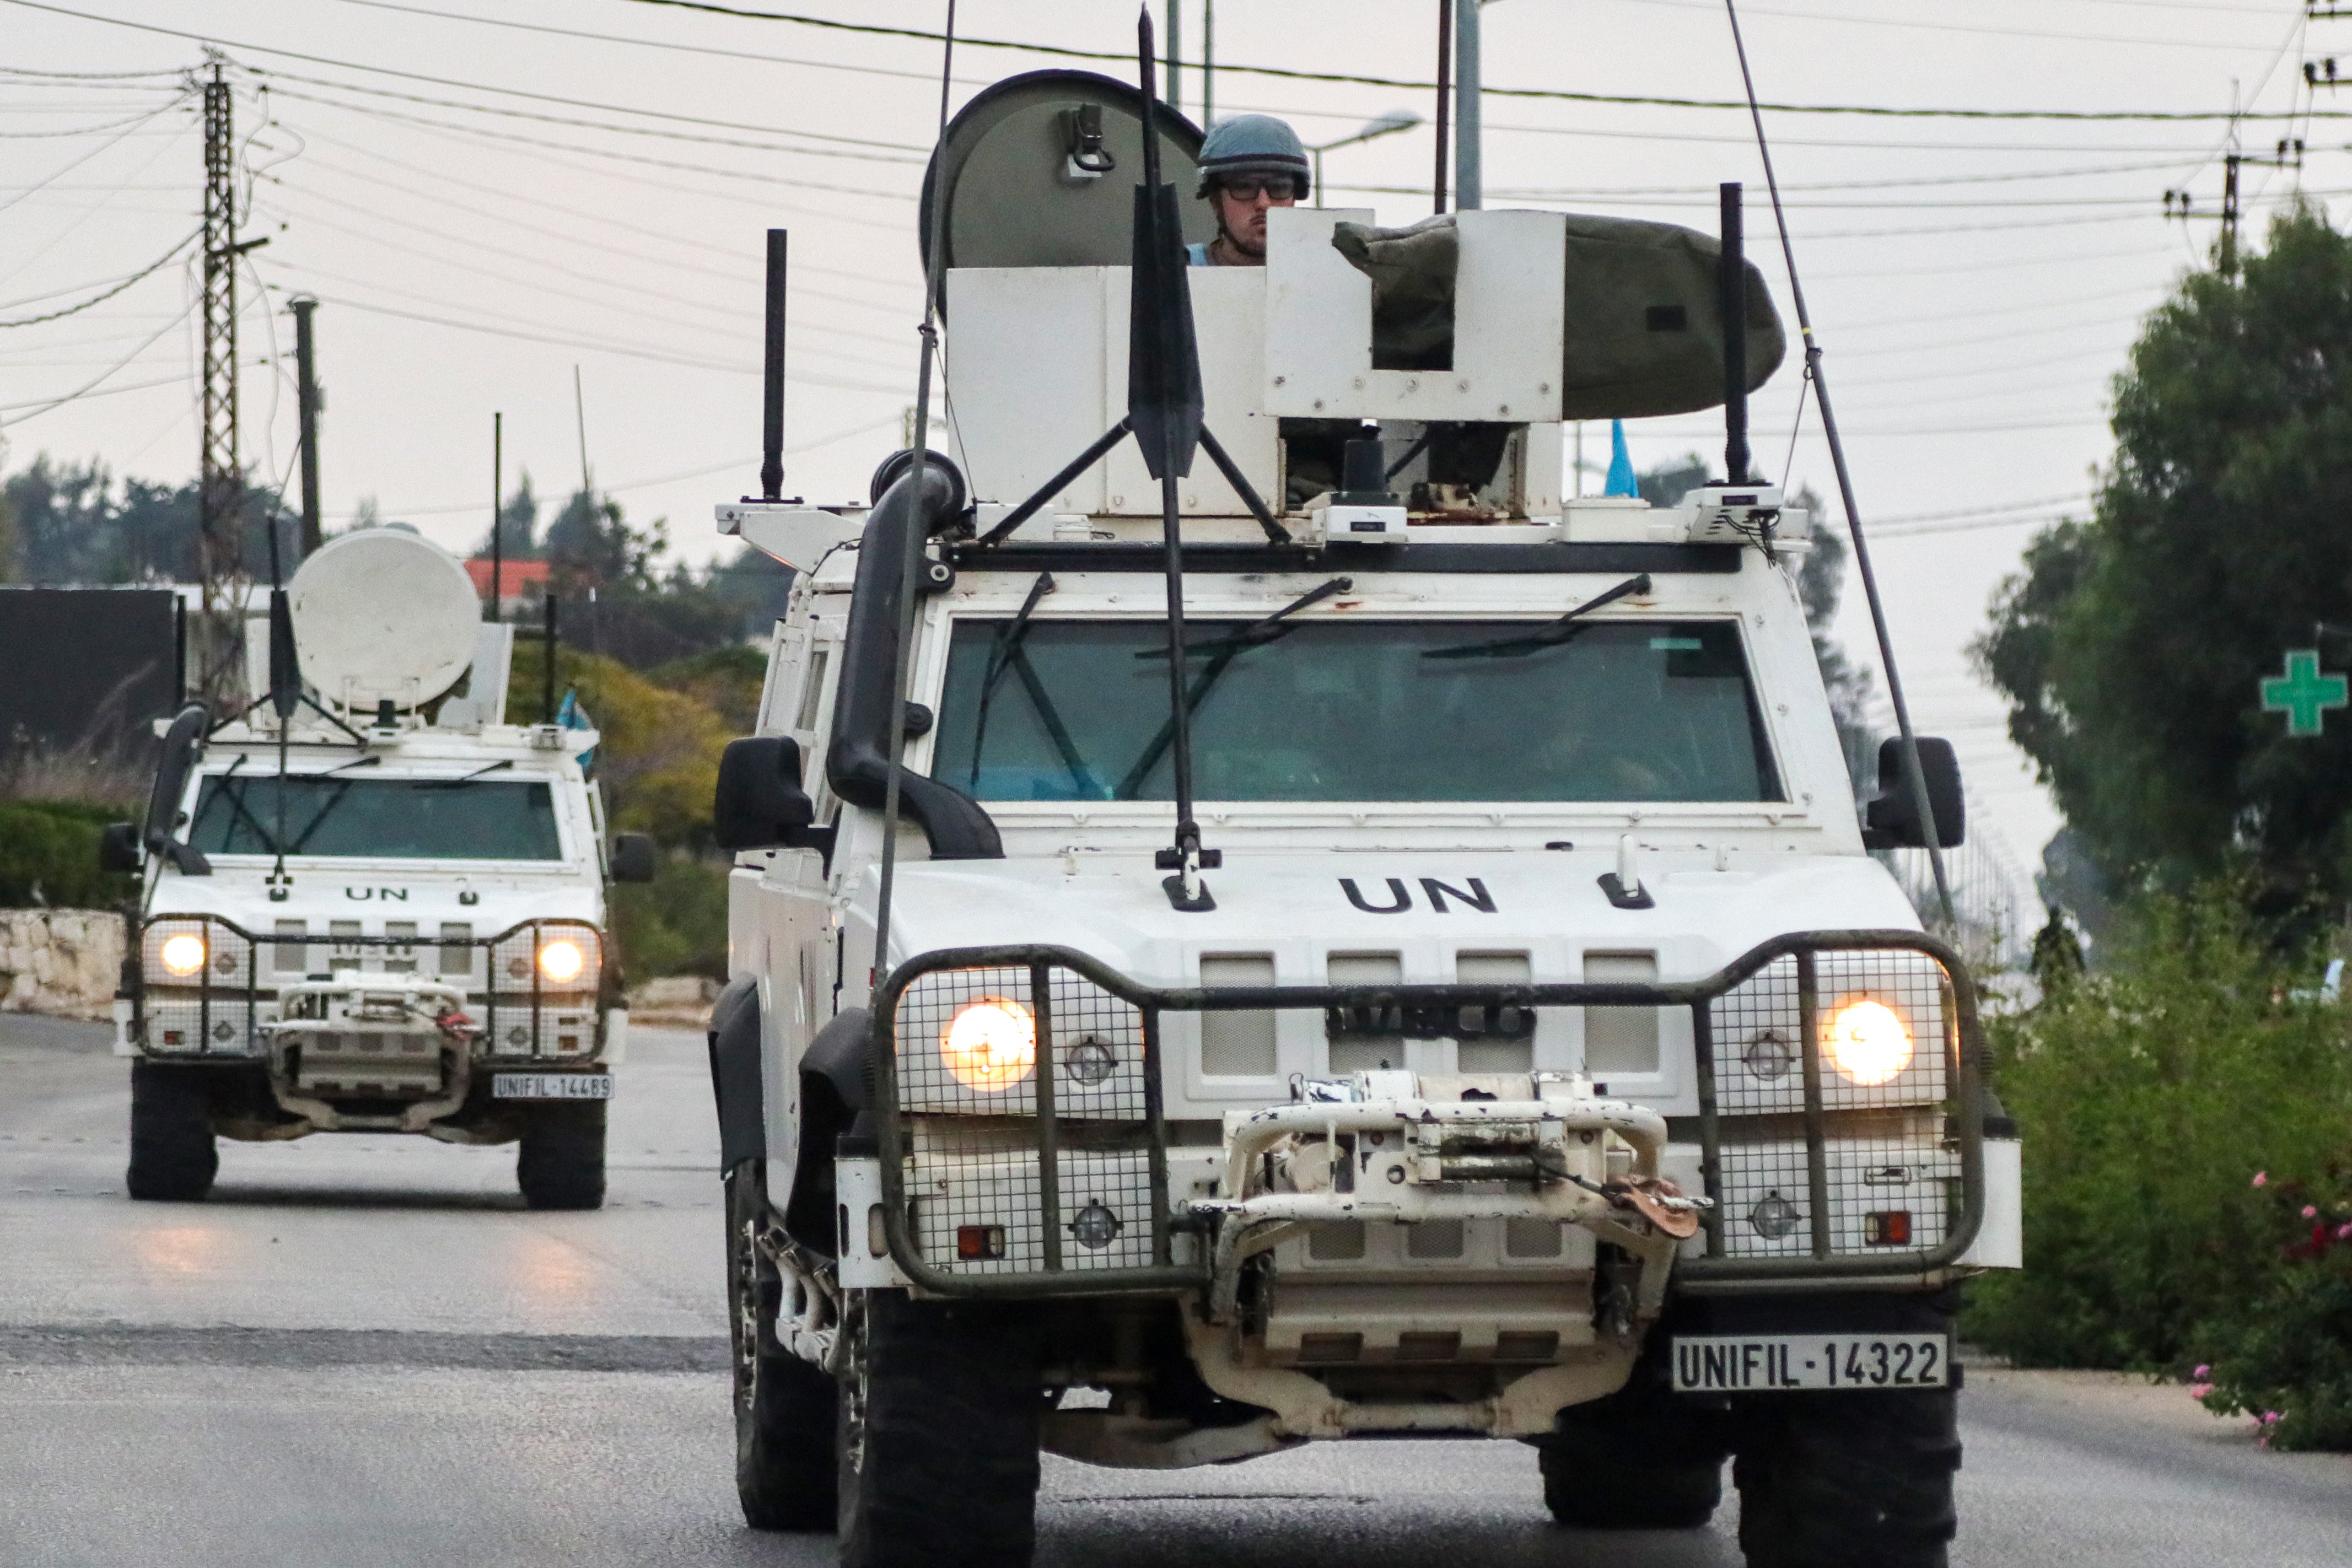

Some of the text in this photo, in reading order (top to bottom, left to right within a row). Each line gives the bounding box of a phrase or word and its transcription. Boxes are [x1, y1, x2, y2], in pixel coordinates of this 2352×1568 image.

[346, 887, 408, 901] UN
[1337, 877, 1499, 914] UN
[1679, 1342, 1939, 1388] UNIFIL-14322
